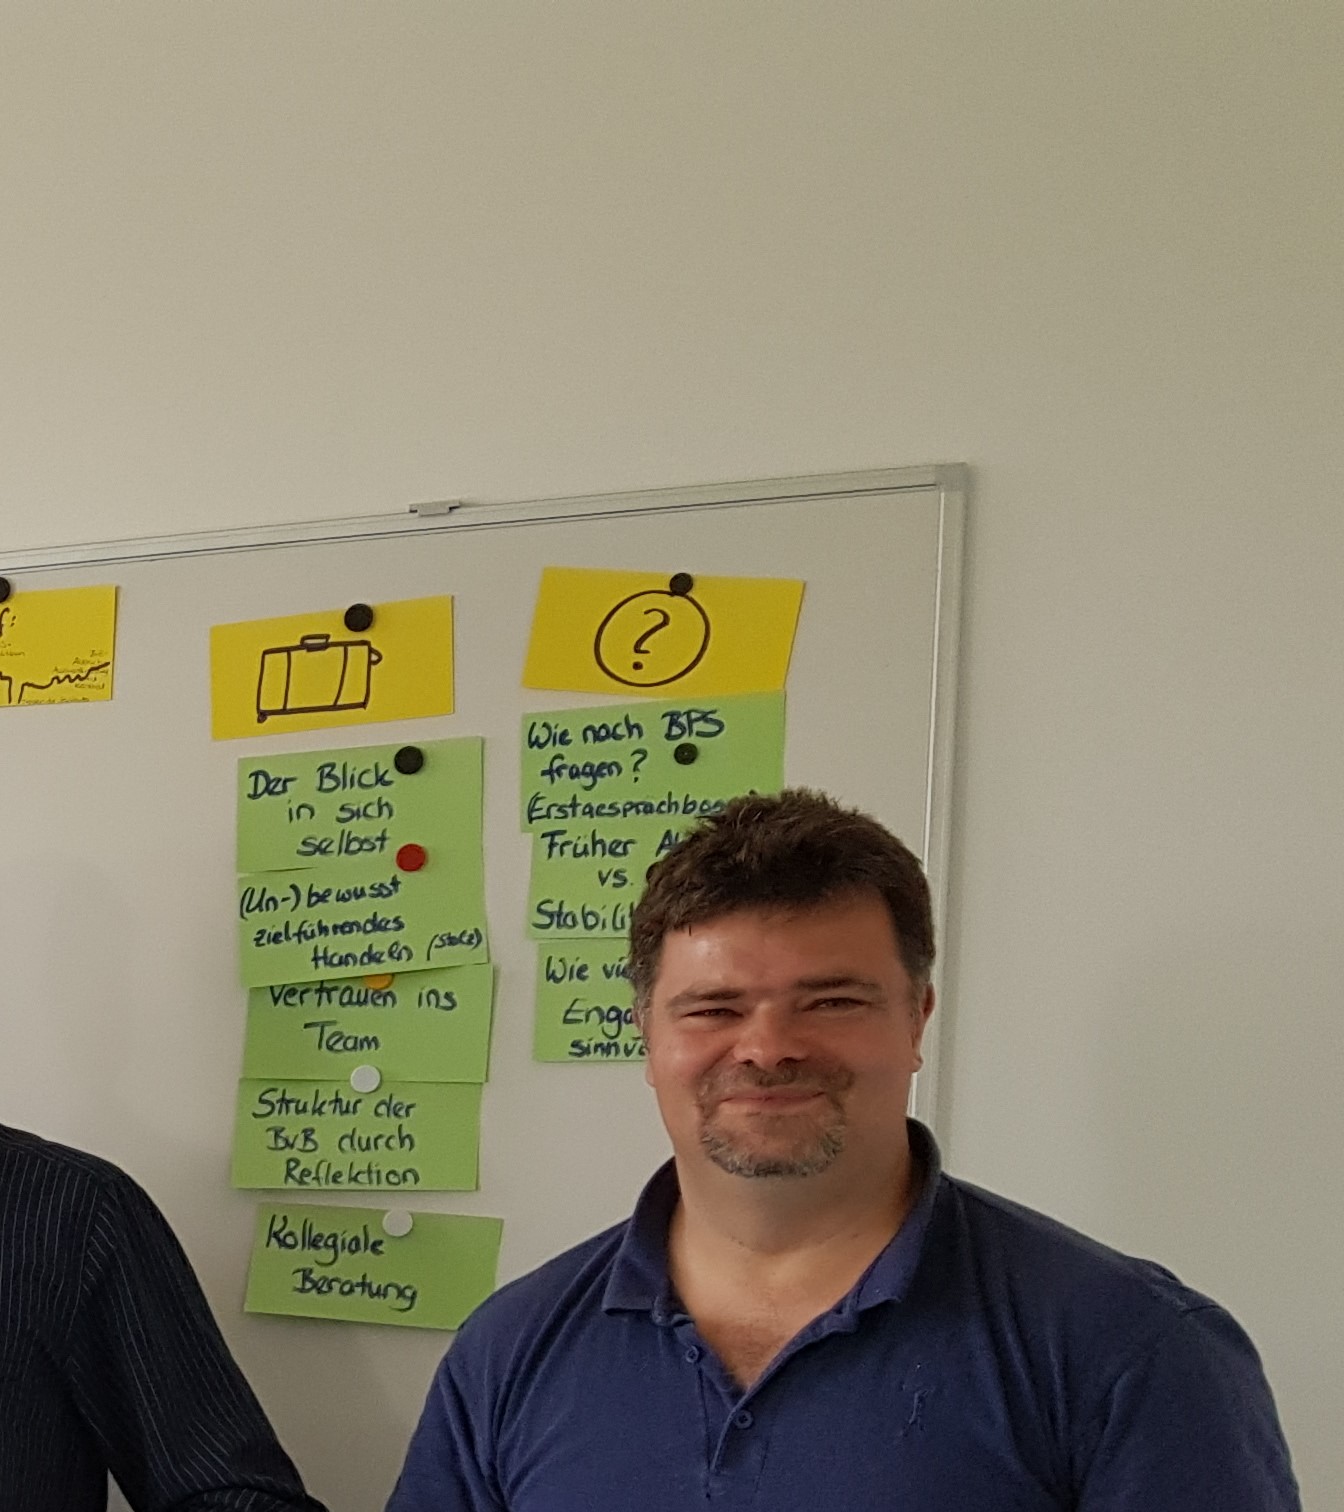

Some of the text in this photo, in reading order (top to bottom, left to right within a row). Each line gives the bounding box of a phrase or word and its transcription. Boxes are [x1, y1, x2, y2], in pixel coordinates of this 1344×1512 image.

[527, 721, 573, 750] Wie
[582, 713, 643, 743] nach
[247, 762, 395, 800] Der Blick
[287, 797, 394, 824] in sich
[296, 828, 391, 858] selbst
[541, 828, 638, 861] Früher
[598, 867, 634, 888] vs.
[253, 911, 405, 948] zielführendes
[311, 939, 414, 971] Handeln
[545, 955, 590, 985] Wie
[417, 987, 458, 1012] ins
[303, 1019, 381, 1053] Team
[252, 1088, 417, 1120] Struktur der
[337, 1123, 416, 1154] durch
[283, 1157, 421, 1187] Reflektion
[265, 1213, 386, 1267] Kollegiale
[291, 1267, 419, 1313] Beratung
